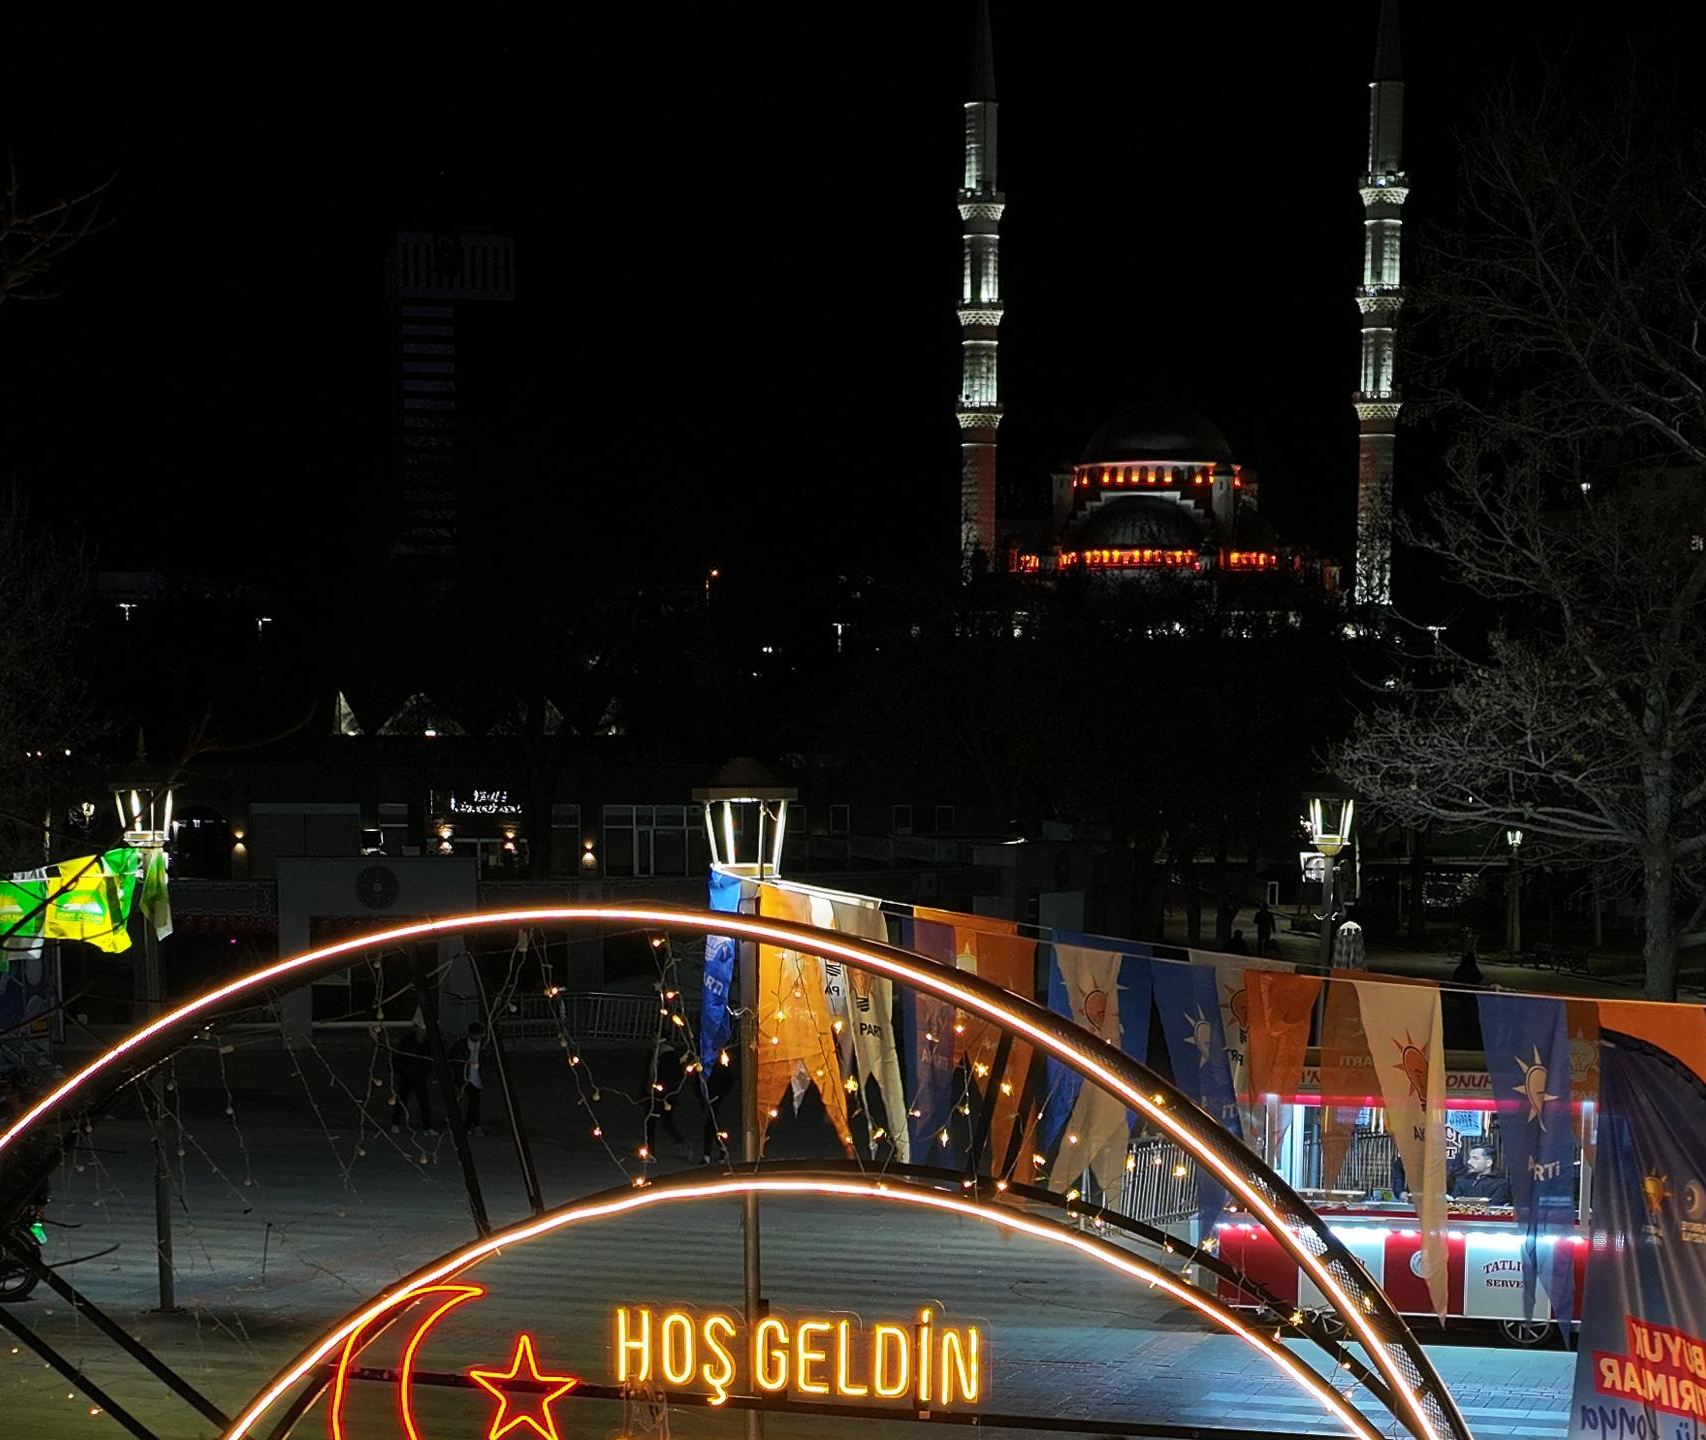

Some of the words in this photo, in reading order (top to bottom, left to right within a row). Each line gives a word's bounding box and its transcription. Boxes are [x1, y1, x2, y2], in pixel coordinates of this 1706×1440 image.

[1483, 1260, 1523, 1275] TATLI
[614, 1305, 737, 1406] HOŞ
[752, 1302, 981, 1404] GELDİN
